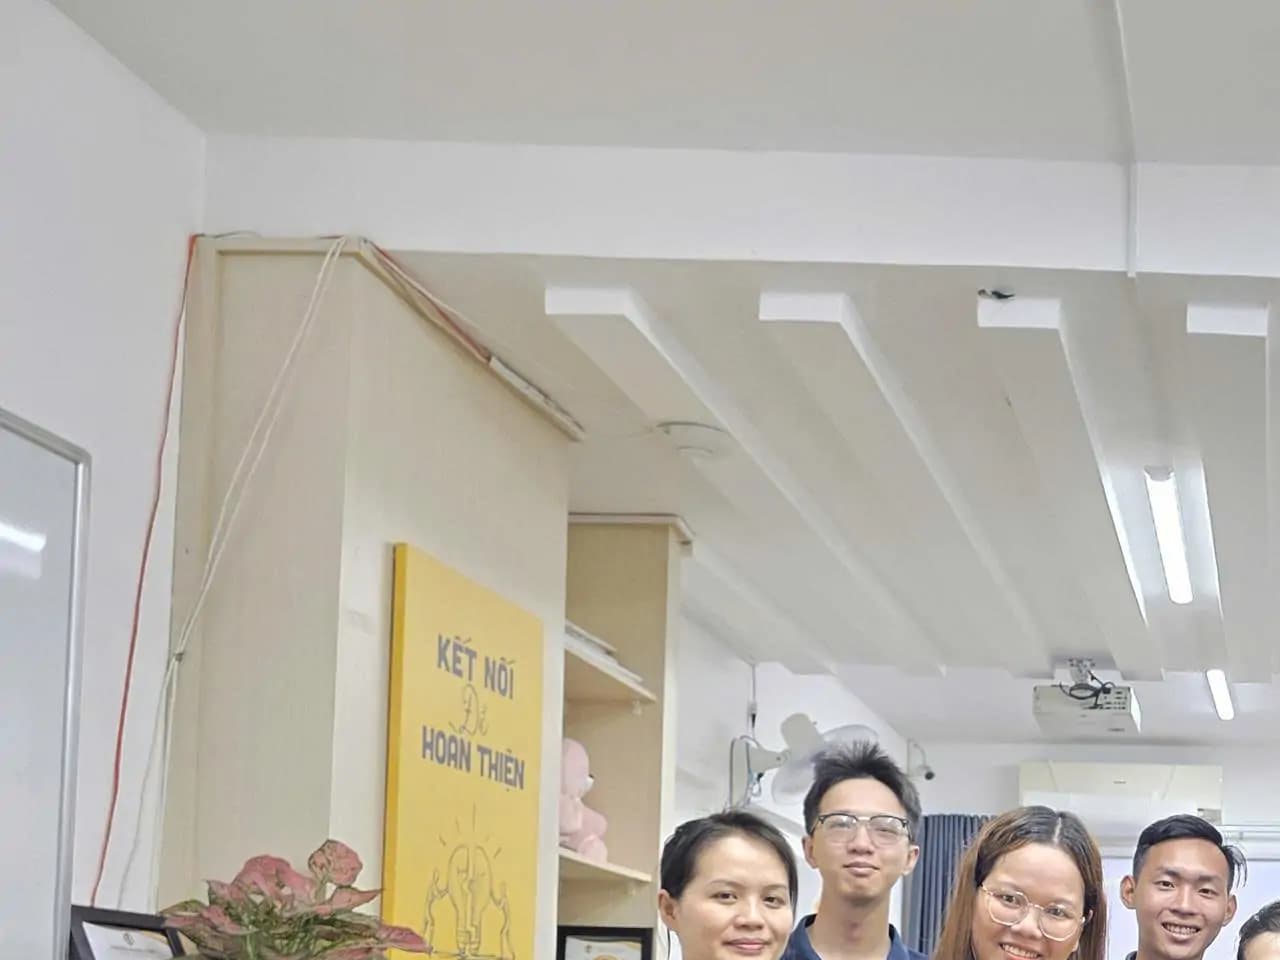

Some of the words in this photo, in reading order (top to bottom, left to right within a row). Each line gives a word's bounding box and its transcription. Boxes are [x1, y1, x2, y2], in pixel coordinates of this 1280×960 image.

[437, 633, 477, 682] KẾT
[484, 656, 516, 700] NỐI
[476, 744, 525, 792] THIỆN
